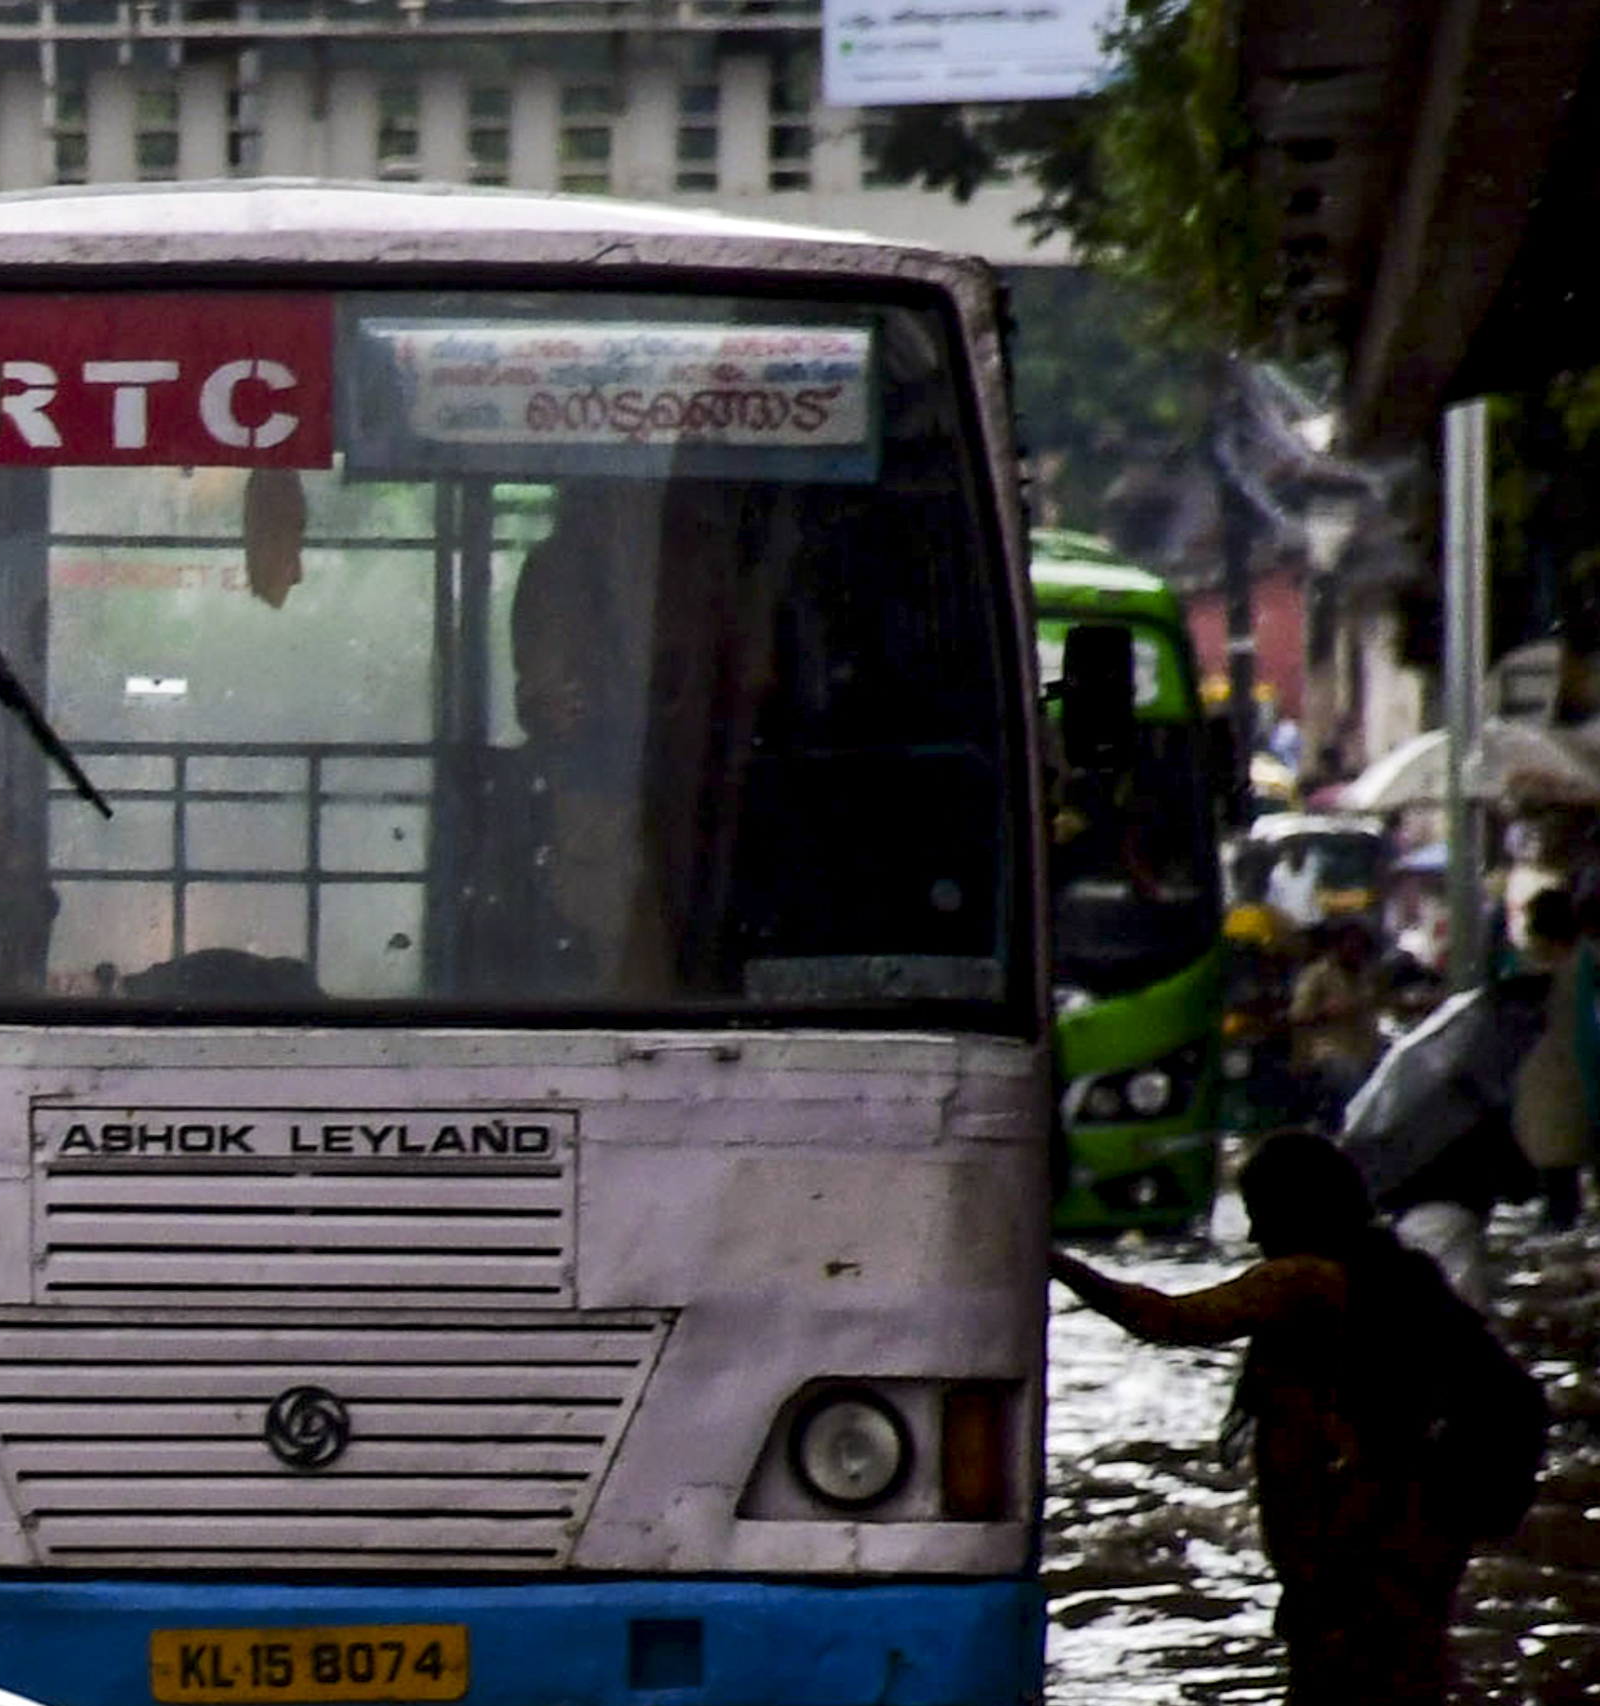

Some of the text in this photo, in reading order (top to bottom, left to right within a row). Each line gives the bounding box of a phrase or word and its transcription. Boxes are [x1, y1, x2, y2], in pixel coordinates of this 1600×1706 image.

[58, 1123, 550, 1154] ASHOK LEYLAND
[311, 1640, 443, 1684] 8074
